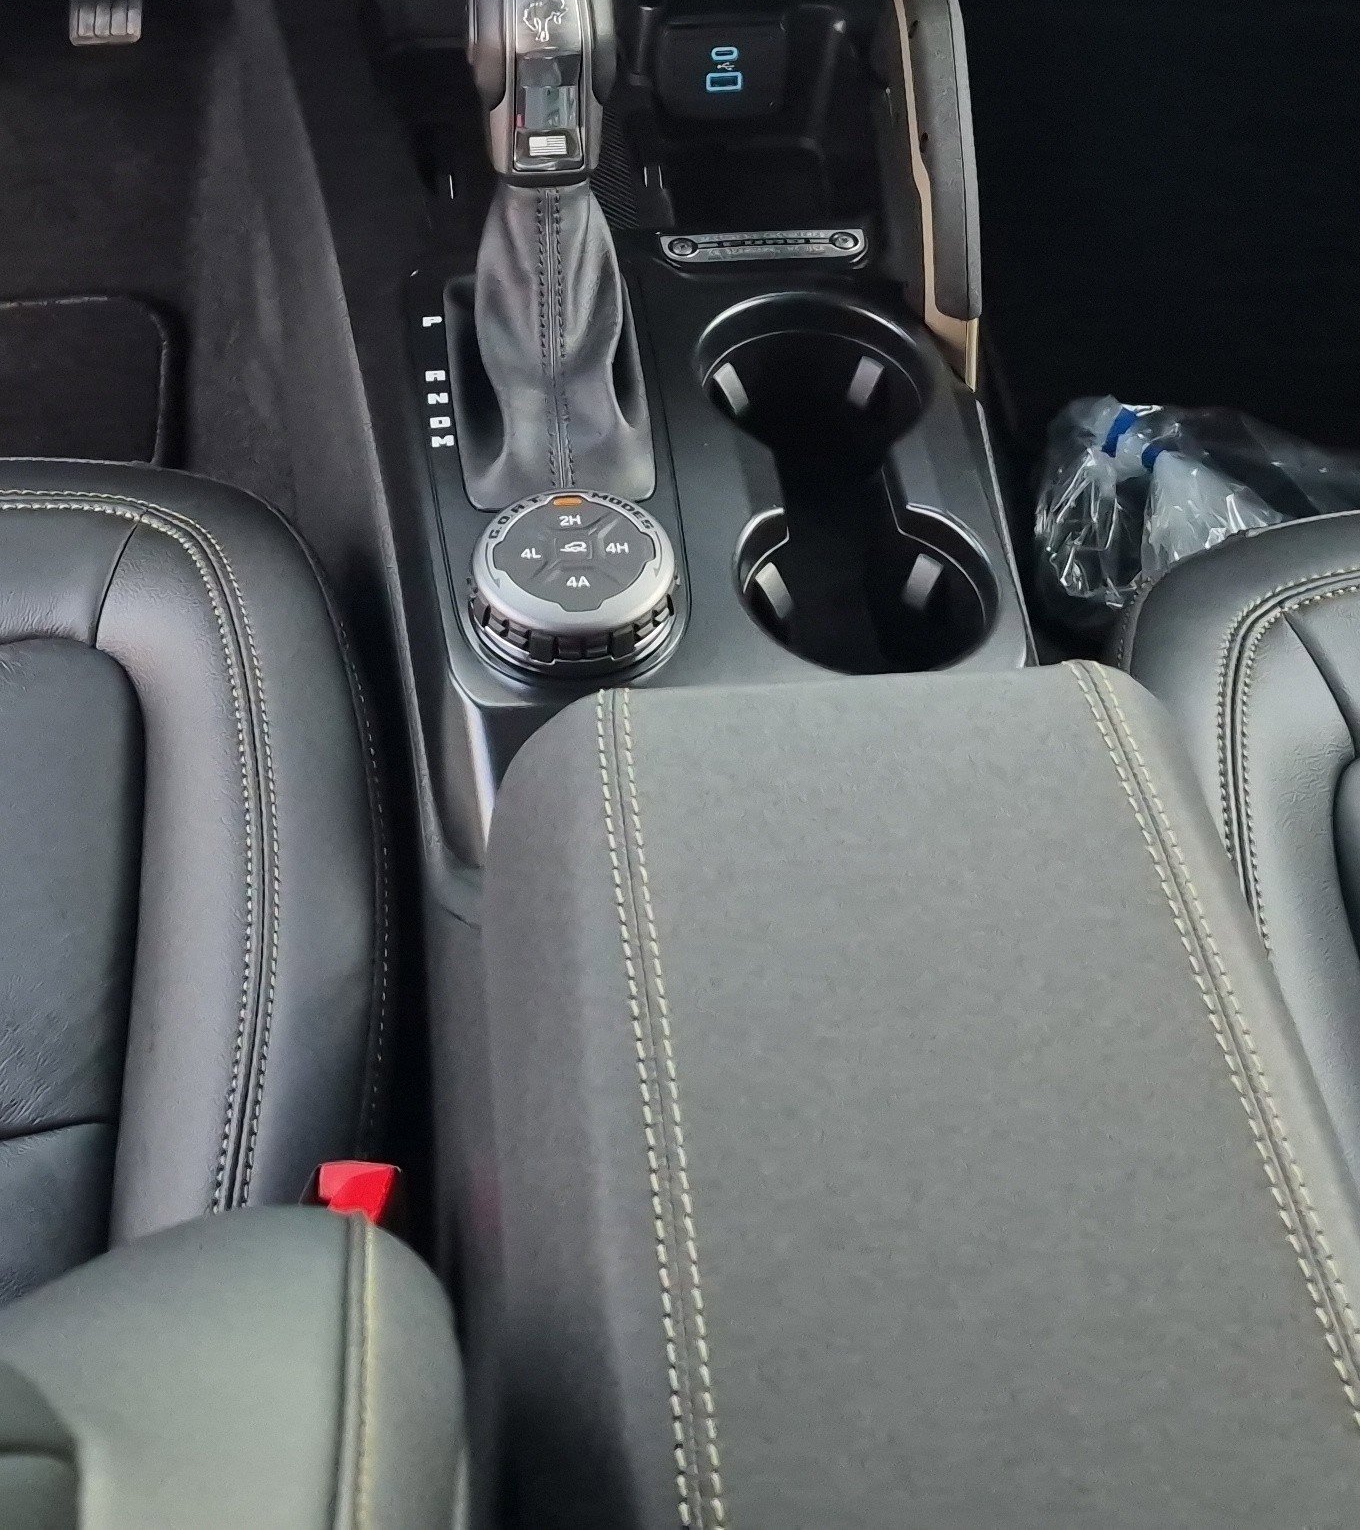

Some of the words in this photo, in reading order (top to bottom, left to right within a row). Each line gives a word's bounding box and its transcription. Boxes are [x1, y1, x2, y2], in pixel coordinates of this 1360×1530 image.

[423, 316, 442, 327] P
[428, 393, 448, 404] N
[430, 417, 450, 428] D
[432, 435, 454, 447] M
[592, 492, 654, 530] MODES
[559, 515, 582, 526] 2H
[521, 548, 541, 559] 4L
[606, 543, 629, 554] 4H
[566, 576, 590, 587] 4A
